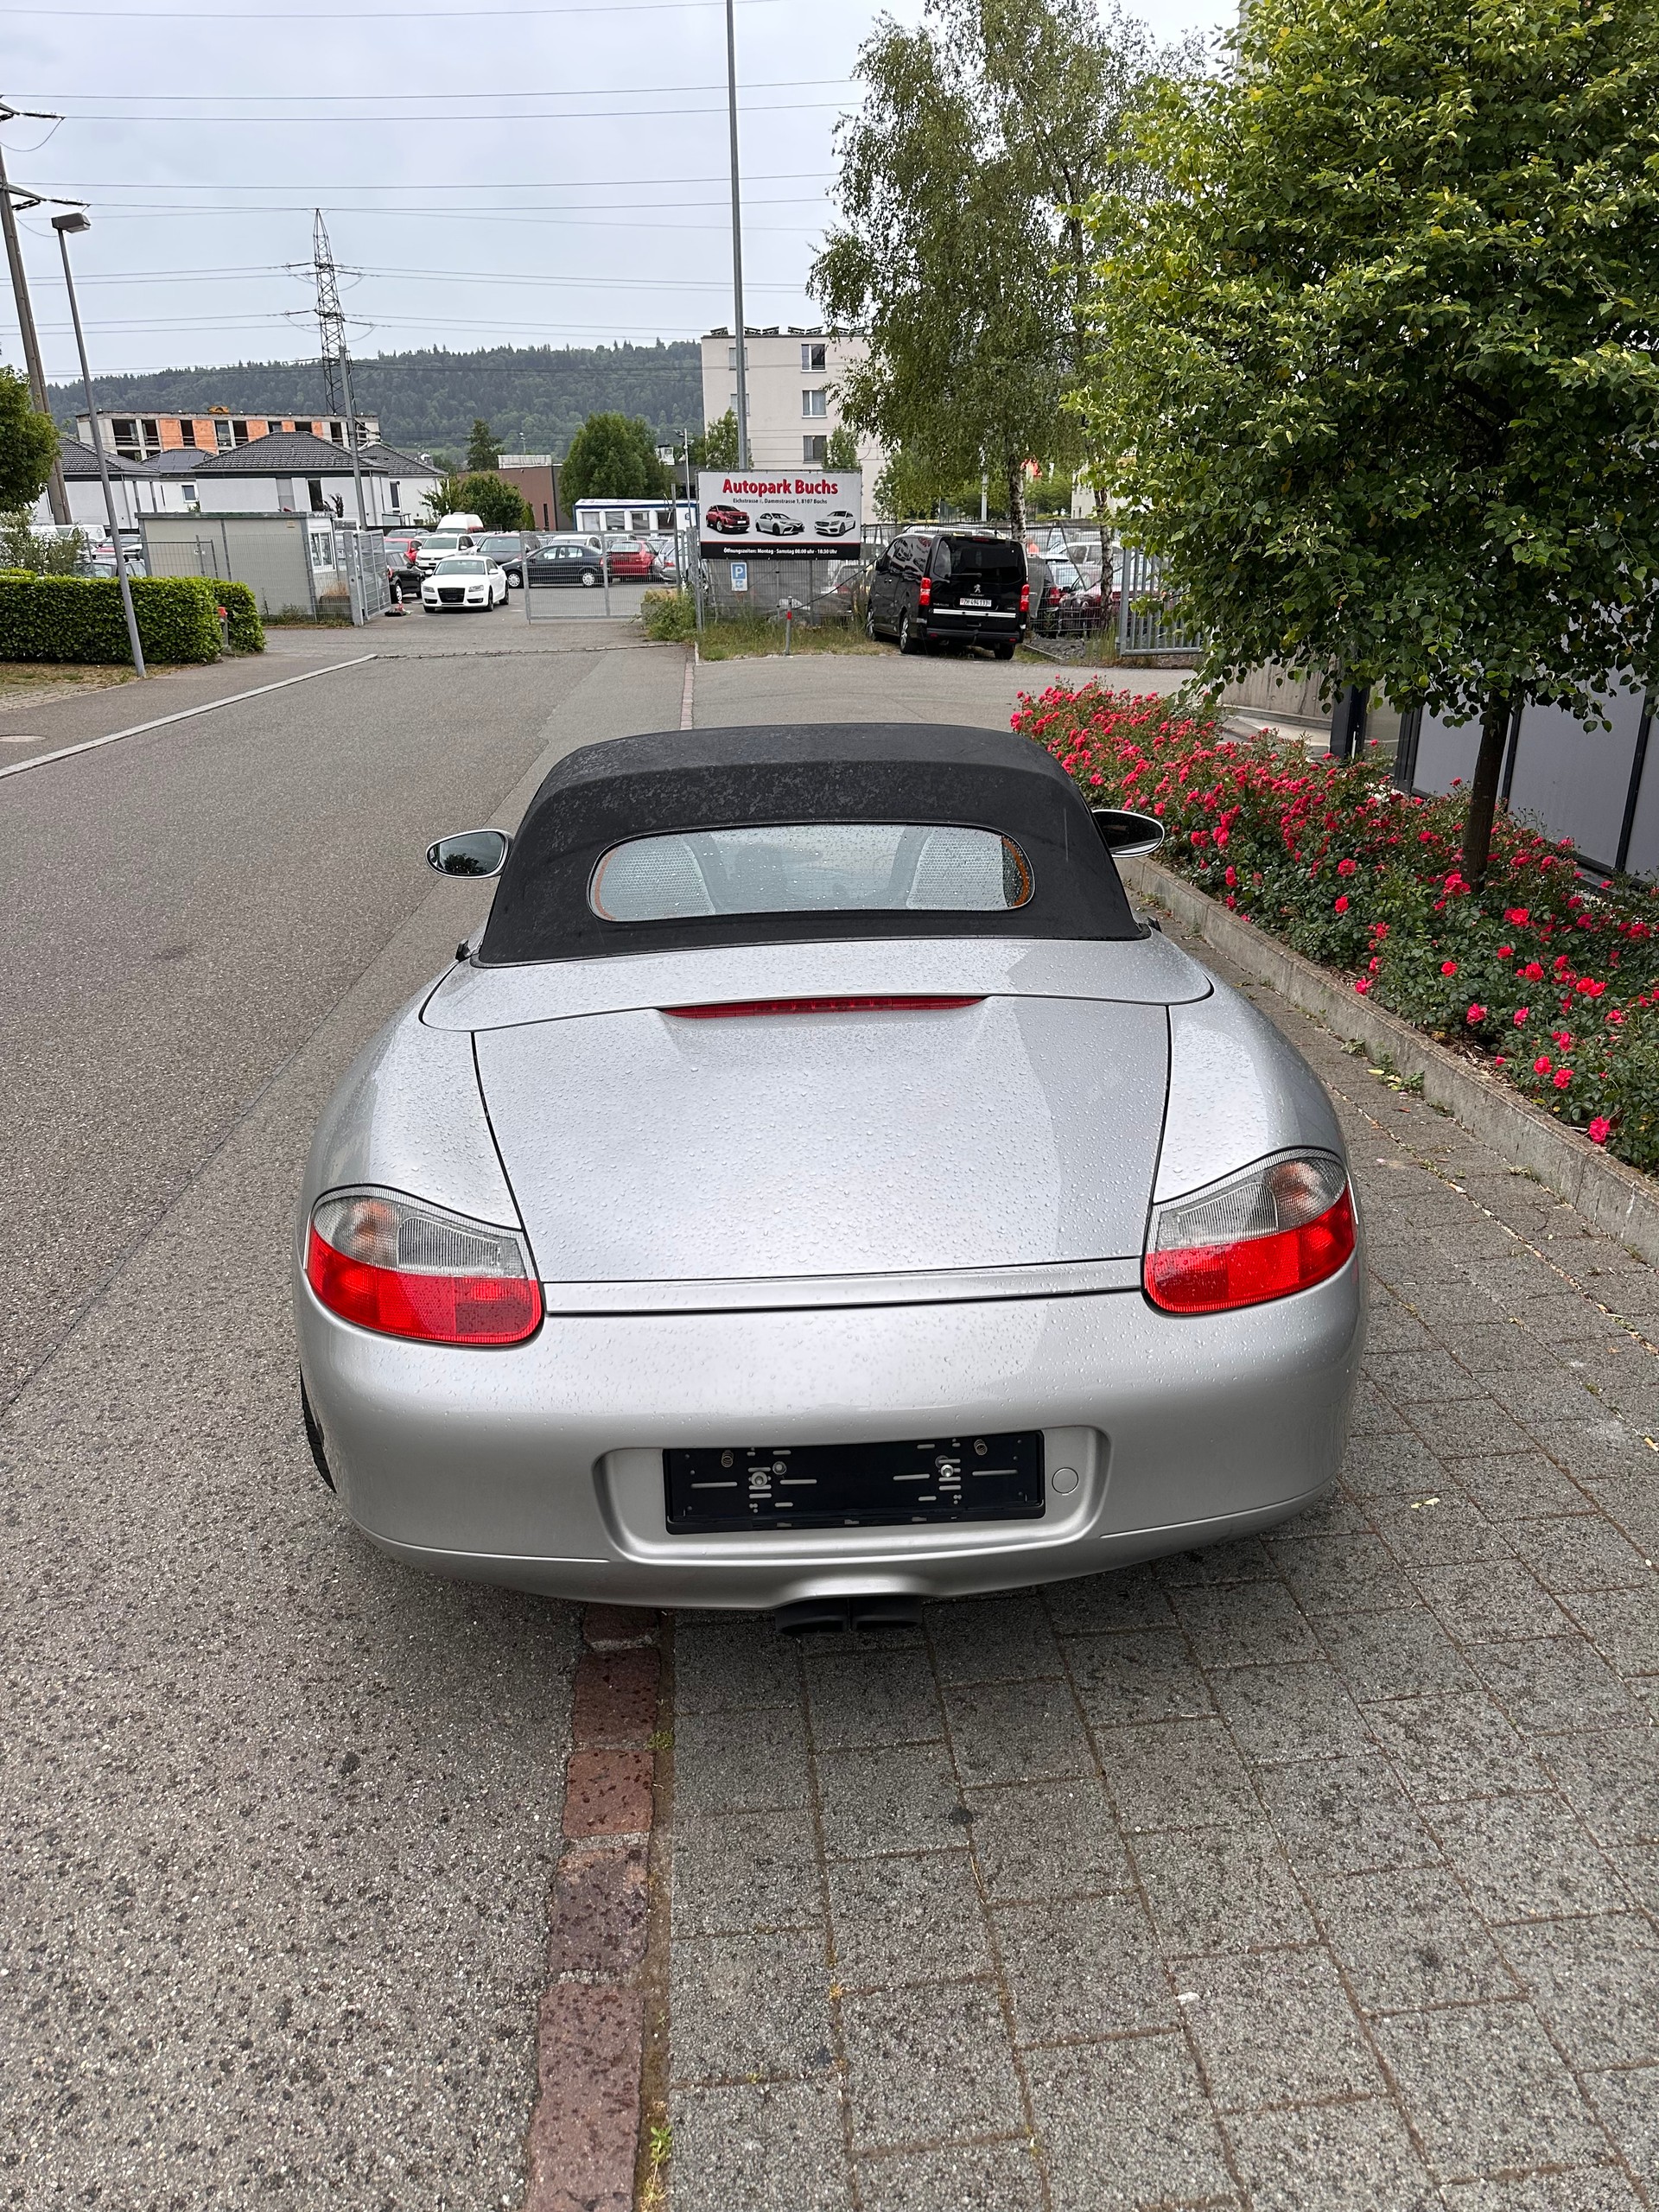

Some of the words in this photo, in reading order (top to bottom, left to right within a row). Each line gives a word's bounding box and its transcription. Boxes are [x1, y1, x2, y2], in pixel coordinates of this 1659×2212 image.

[722, 479, 791, 497] Autopark
[795, 479, 838, 494] Buchs
[735, 566, 743, 578] P
